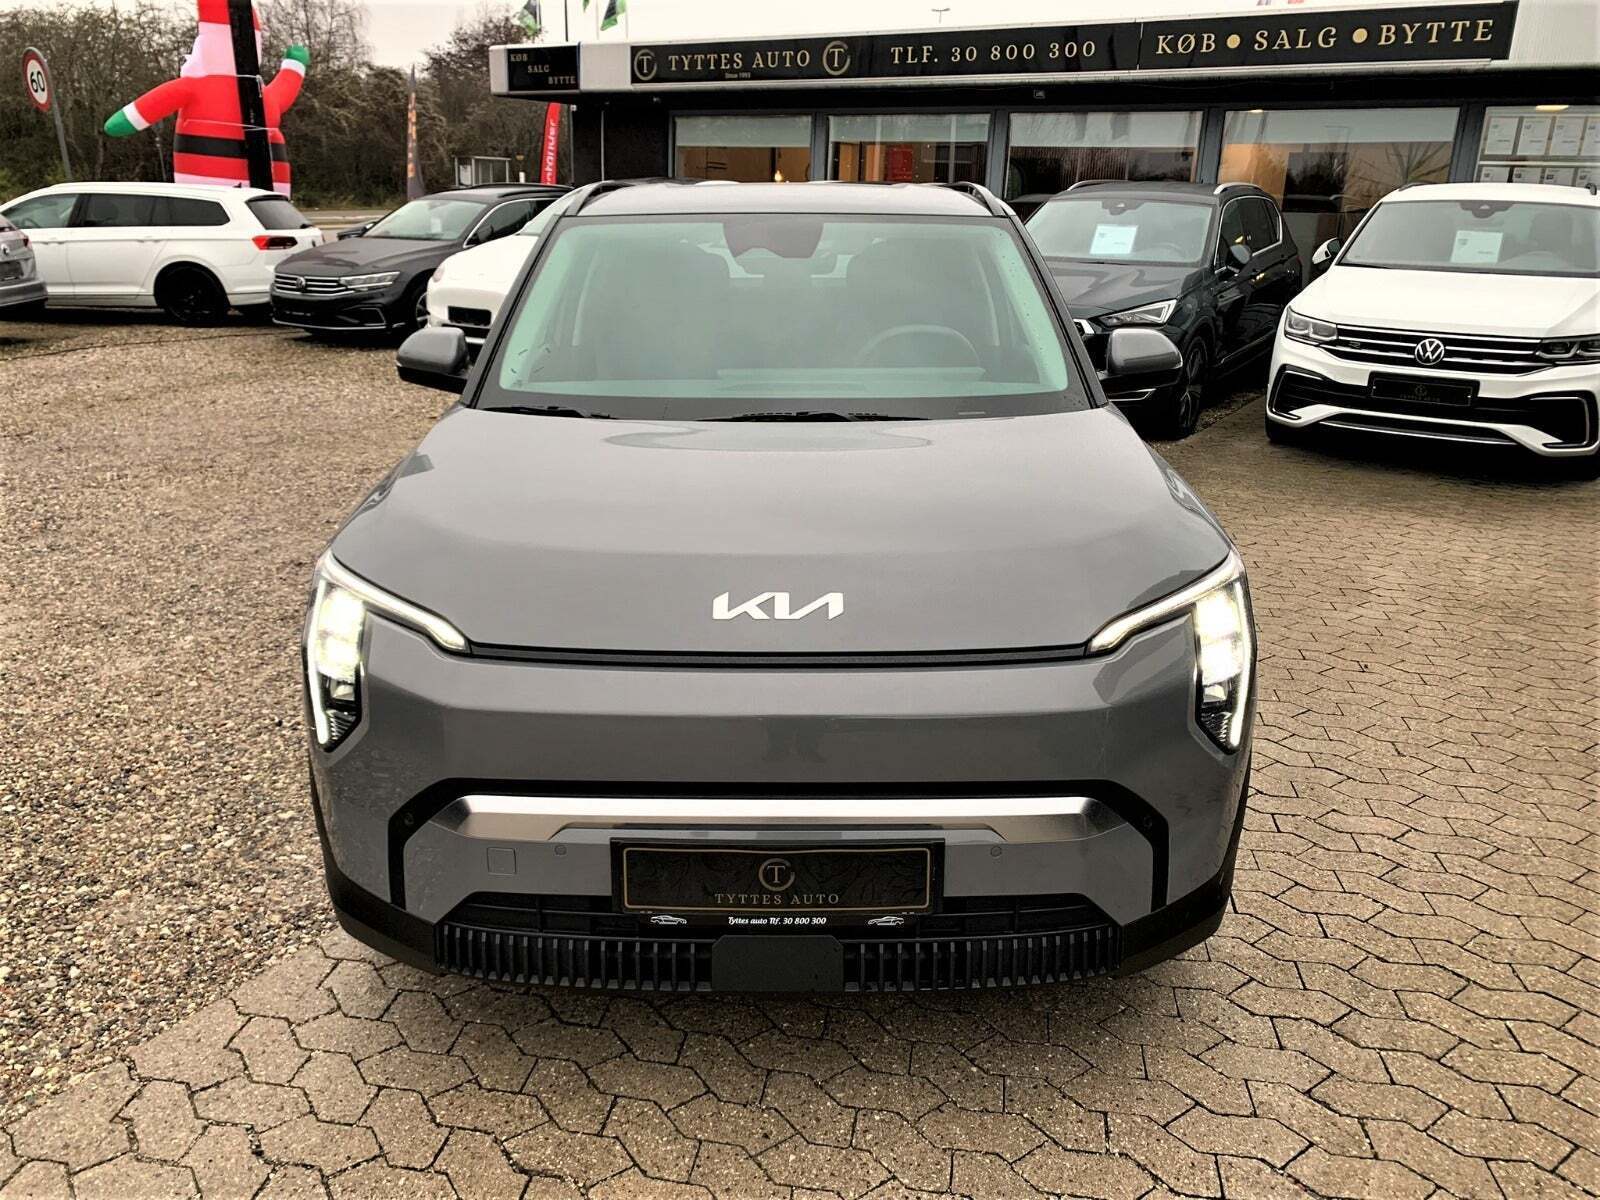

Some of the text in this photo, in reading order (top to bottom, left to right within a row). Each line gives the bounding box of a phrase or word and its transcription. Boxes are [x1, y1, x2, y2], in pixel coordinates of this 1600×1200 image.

[1156, 19, 1494, 54] KØB SALG BYTTE
[668, 49, 811, 71] TYTTES AUTO
[891, 41, 1096, 64] TLF. 30 800 300
[30, 70, 46, 93] 60
[712, 591, 844, 620] KIA
[714, 893, 839, 905] TYTTES AUTO
[728, 916, 749, 925] Tyttes
[750, 917, 768, 925] auto
[783, 917, 793, 925] 30
[794, 917, 809, 925] 800
[811, 917, 827, 925] 300
